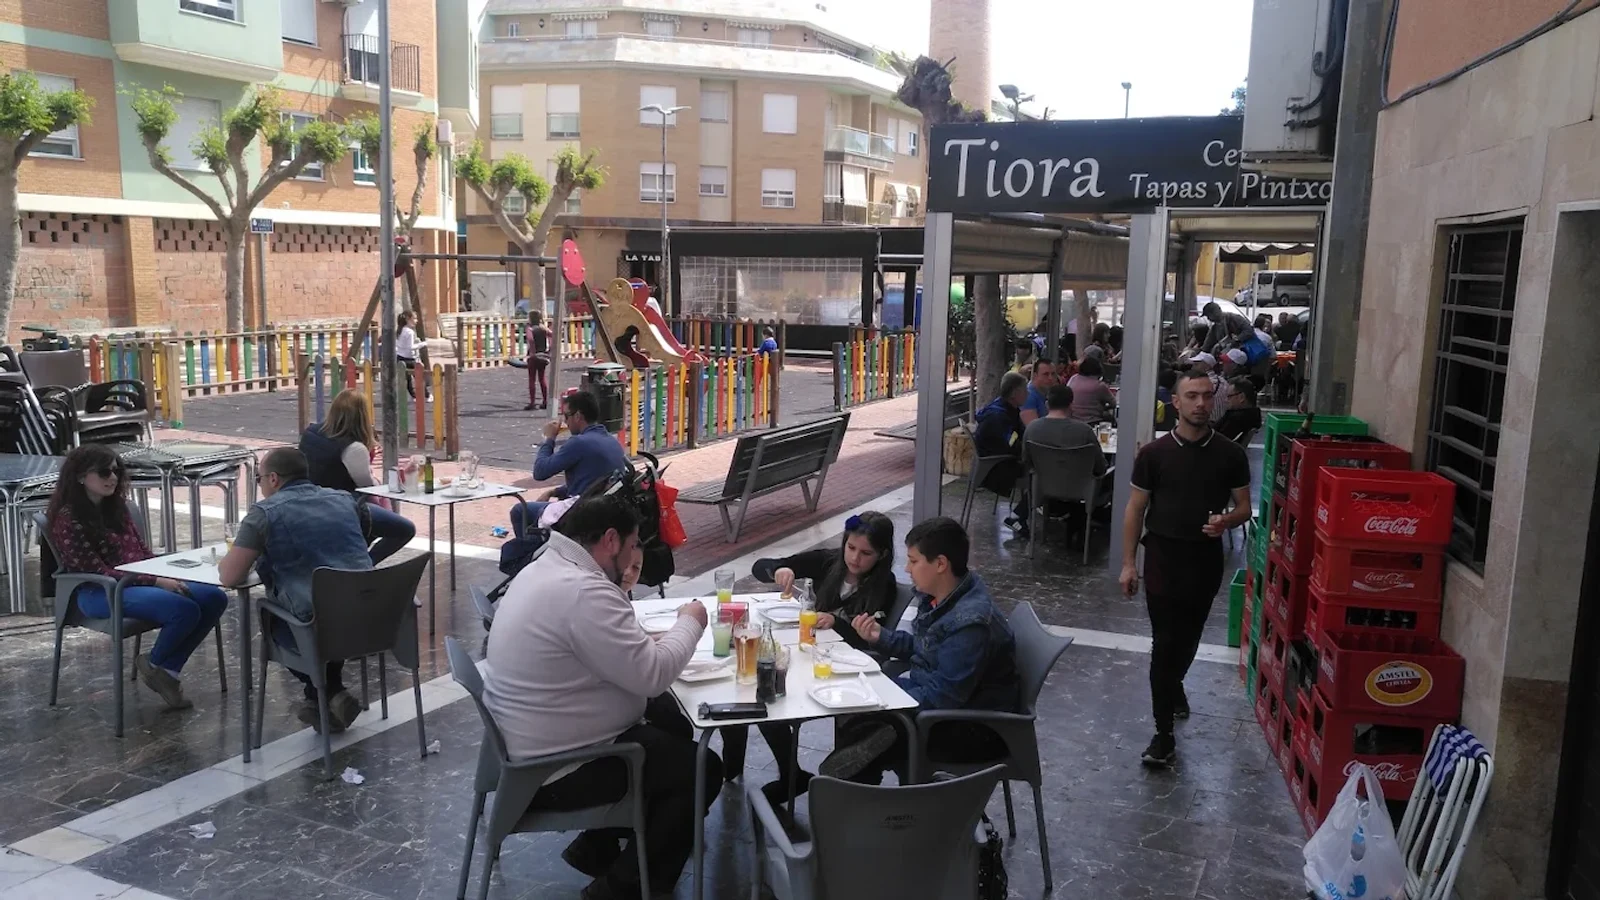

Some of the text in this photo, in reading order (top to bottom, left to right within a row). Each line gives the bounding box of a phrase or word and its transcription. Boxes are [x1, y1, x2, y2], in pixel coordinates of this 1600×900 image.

[944, 138, 1106, 198] Tiora
[1129, 172, 1332, 208] Tapas y Pintxo
[1364, 516, 1419, 535] Coca-Cola
[1377, 670, 1417, 681] AMSTEL
